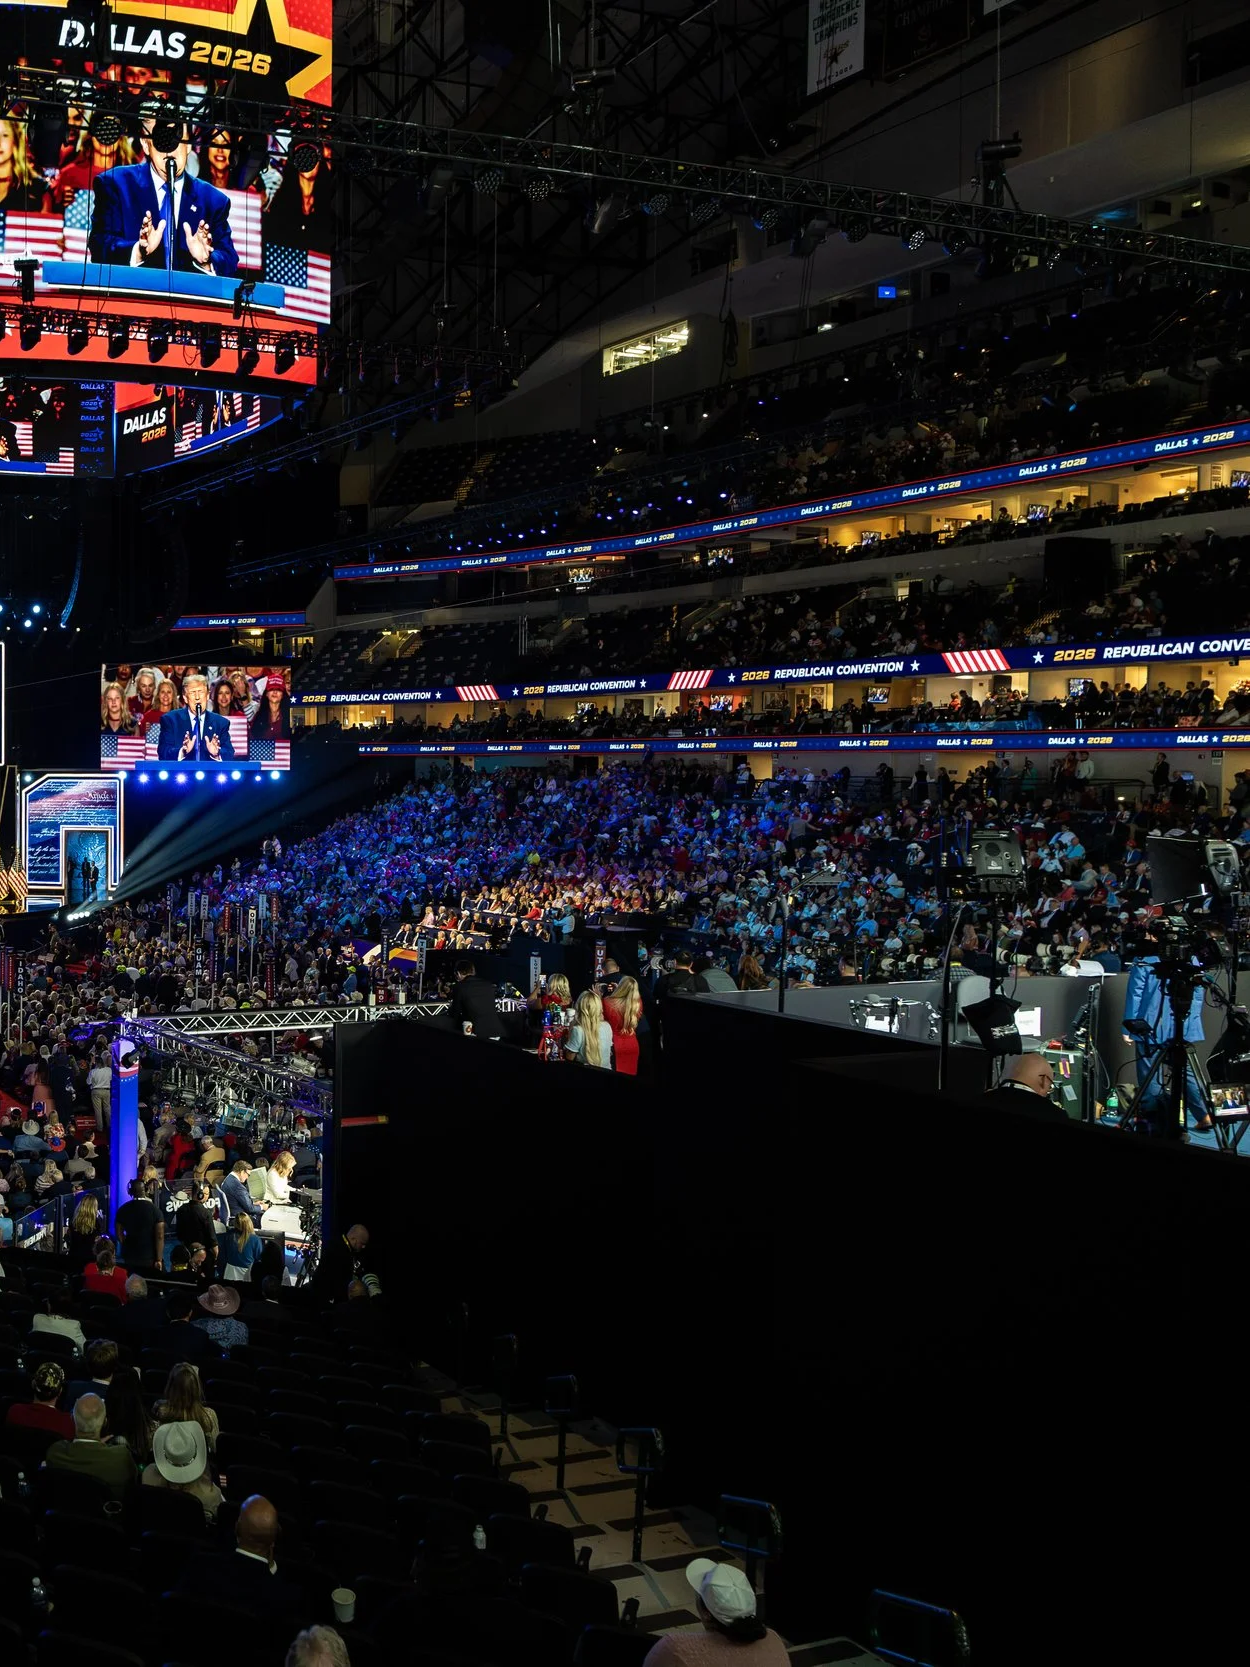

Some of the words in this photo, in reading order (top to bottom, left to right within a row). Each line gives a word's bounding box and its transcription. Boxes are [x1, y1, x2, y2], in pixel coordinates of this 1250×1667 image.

[58, 19, 186, 59] DLLAS
[190, 41, 272, 75] 2026
[123, 407, 166, 435] DALLAS
[141, 426, 167, 443] 2026
[1154, 438, 1188, 452] DALLAS
[1019, 464, 1048, 476] DALLAS
[902, 486, 927, 497] DALLAS
[801, 505, 823, 516] DALLAS
[713, 522, 732, 531] DALLAS
[635, 536, 652, 545] DALLAS
[546, 548, 565, 556] DALLAS
[462, 559, 482, 567] DALLAS
[373, 566, 393, 574] DALLAS
[1053, 648, 1097, 662] 2026
[1103, 642, 1195, 659] REPUBLICAN
[1199, 638, 1250, 653] CONVE
[741, 670, 770, 681] 2026
[774, 666, 834, 679] REPUBLICAN
[836, 662, 904, 676] CONVENTION
[523, 686, 545, 695] 2026
[546, 682, 589, 694] REPUBLICAN
[590, 680, 636, 691] CONVENTION
[302, 694, 327, 703] 2026
[330, 693, 381, 702] REPUBLICAN
[382, 691, 432, 701] CONVENTION
[936, 738, 960, 746] DALLAS
[1048, 737, 1076, 745] DALLAS
[1176, 735, 1209, 744] DALLAS
